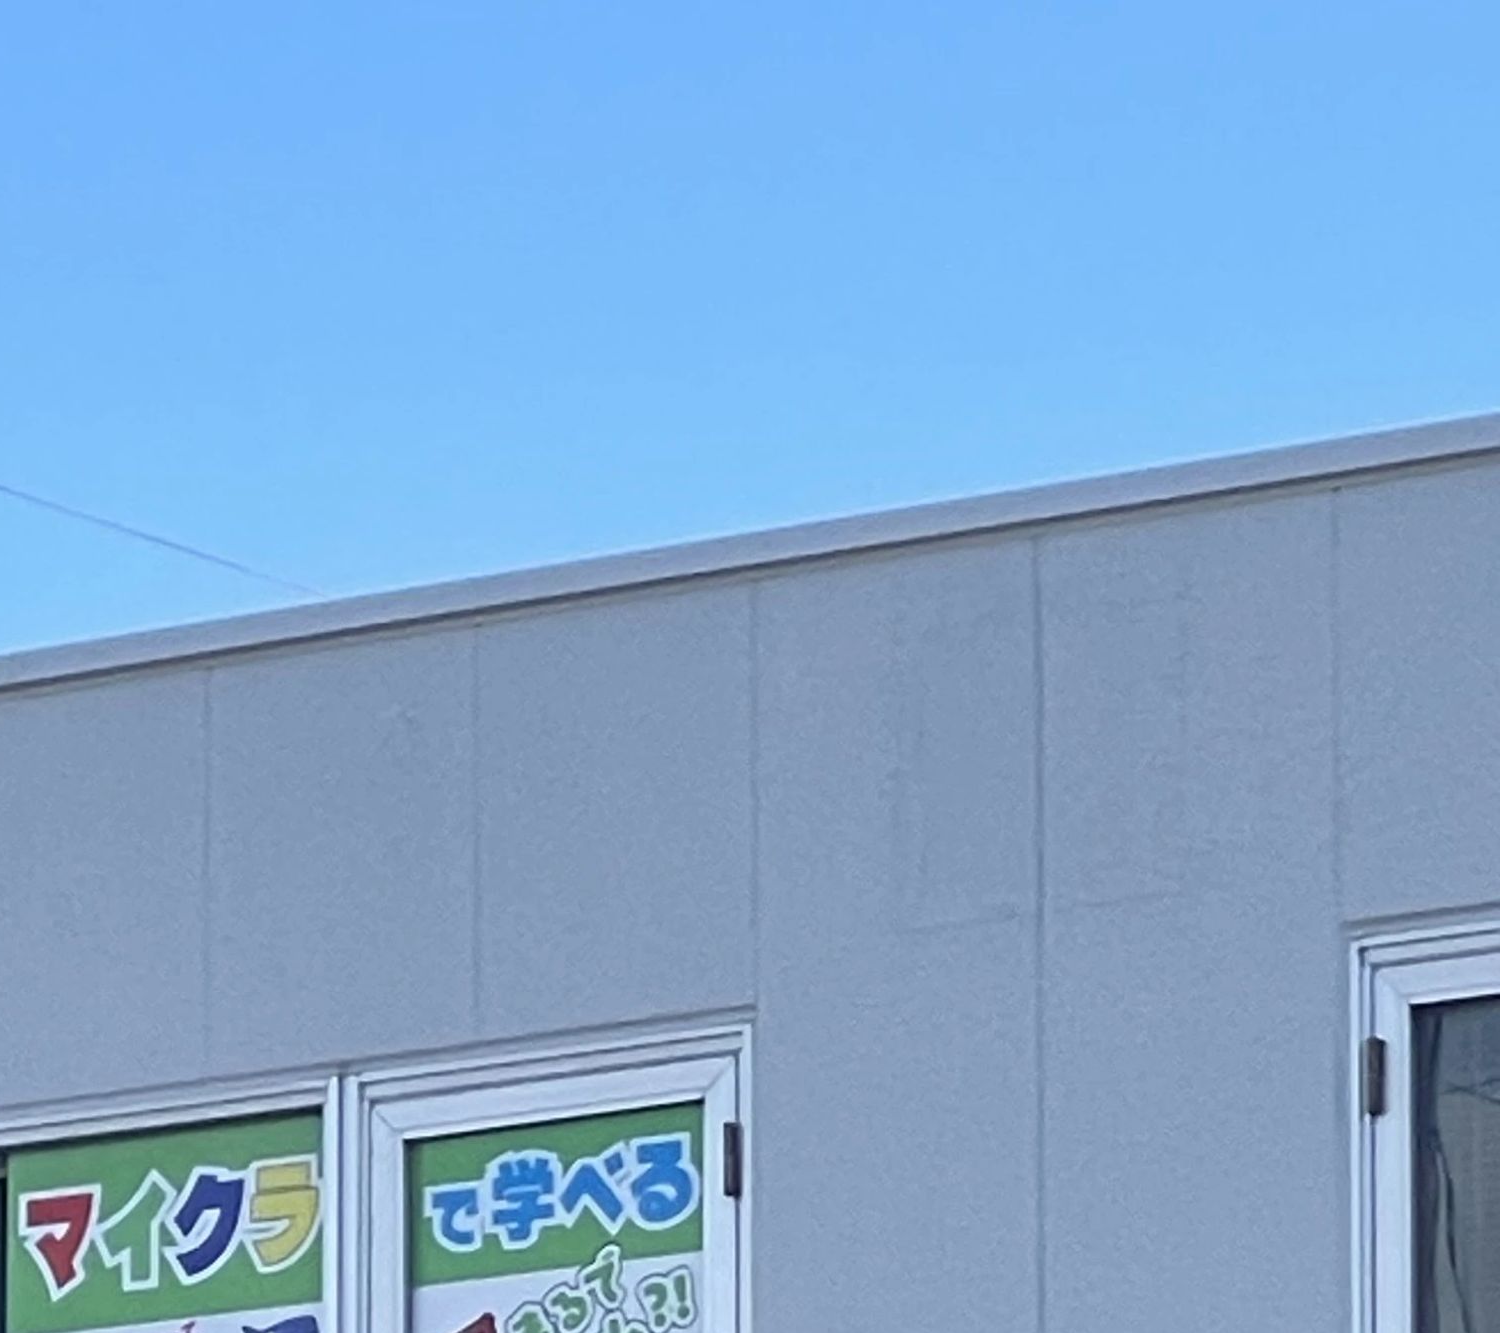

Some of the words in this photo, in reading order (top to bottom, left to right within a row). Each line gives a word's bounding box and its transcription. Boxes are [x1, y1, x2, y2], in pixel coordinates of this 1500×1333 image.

[19, 1154, 323, 1301] マイクラ
[429, 1138, 695, 1248] で学べる
